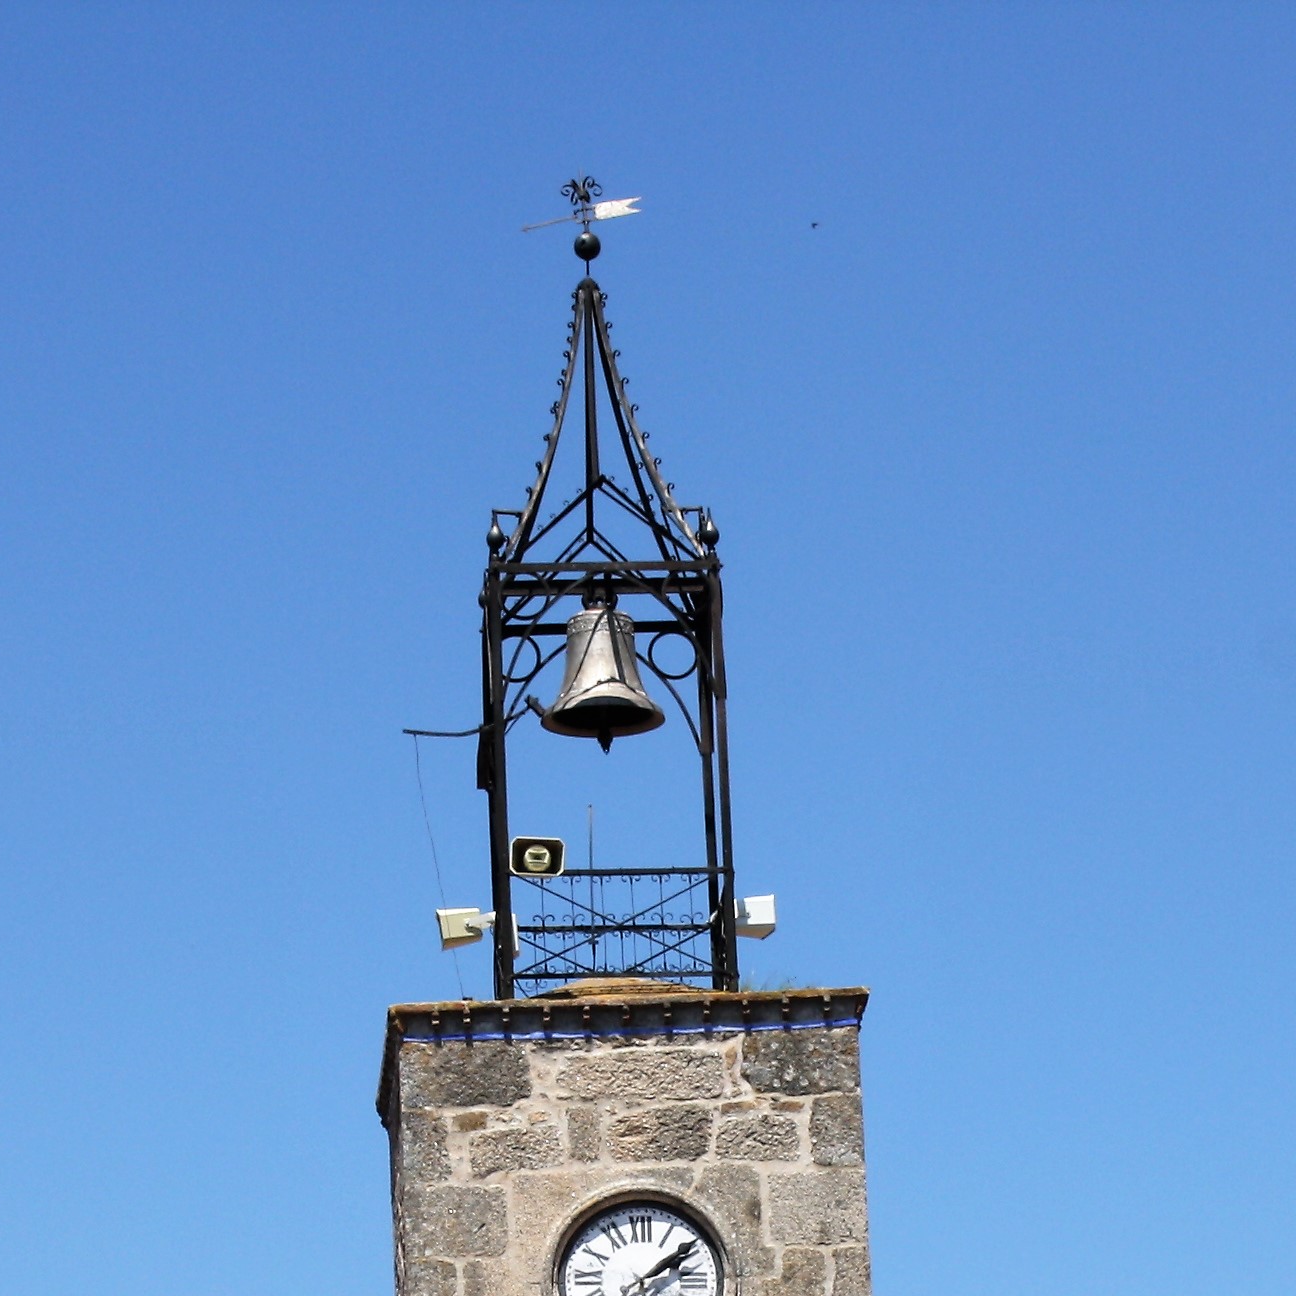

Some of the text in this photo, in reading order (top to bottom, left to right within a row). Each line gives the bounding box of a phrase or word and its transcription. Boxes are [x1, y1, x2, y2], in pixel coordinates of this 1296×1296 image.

[600, 1219, 628, 1253] XI
[628, 1215, 652, 1243] XII
[582, 1244, 610, 1267] X
[574, 1268, 602, 1285] IX
[680, 1272, 707, 1288] III
